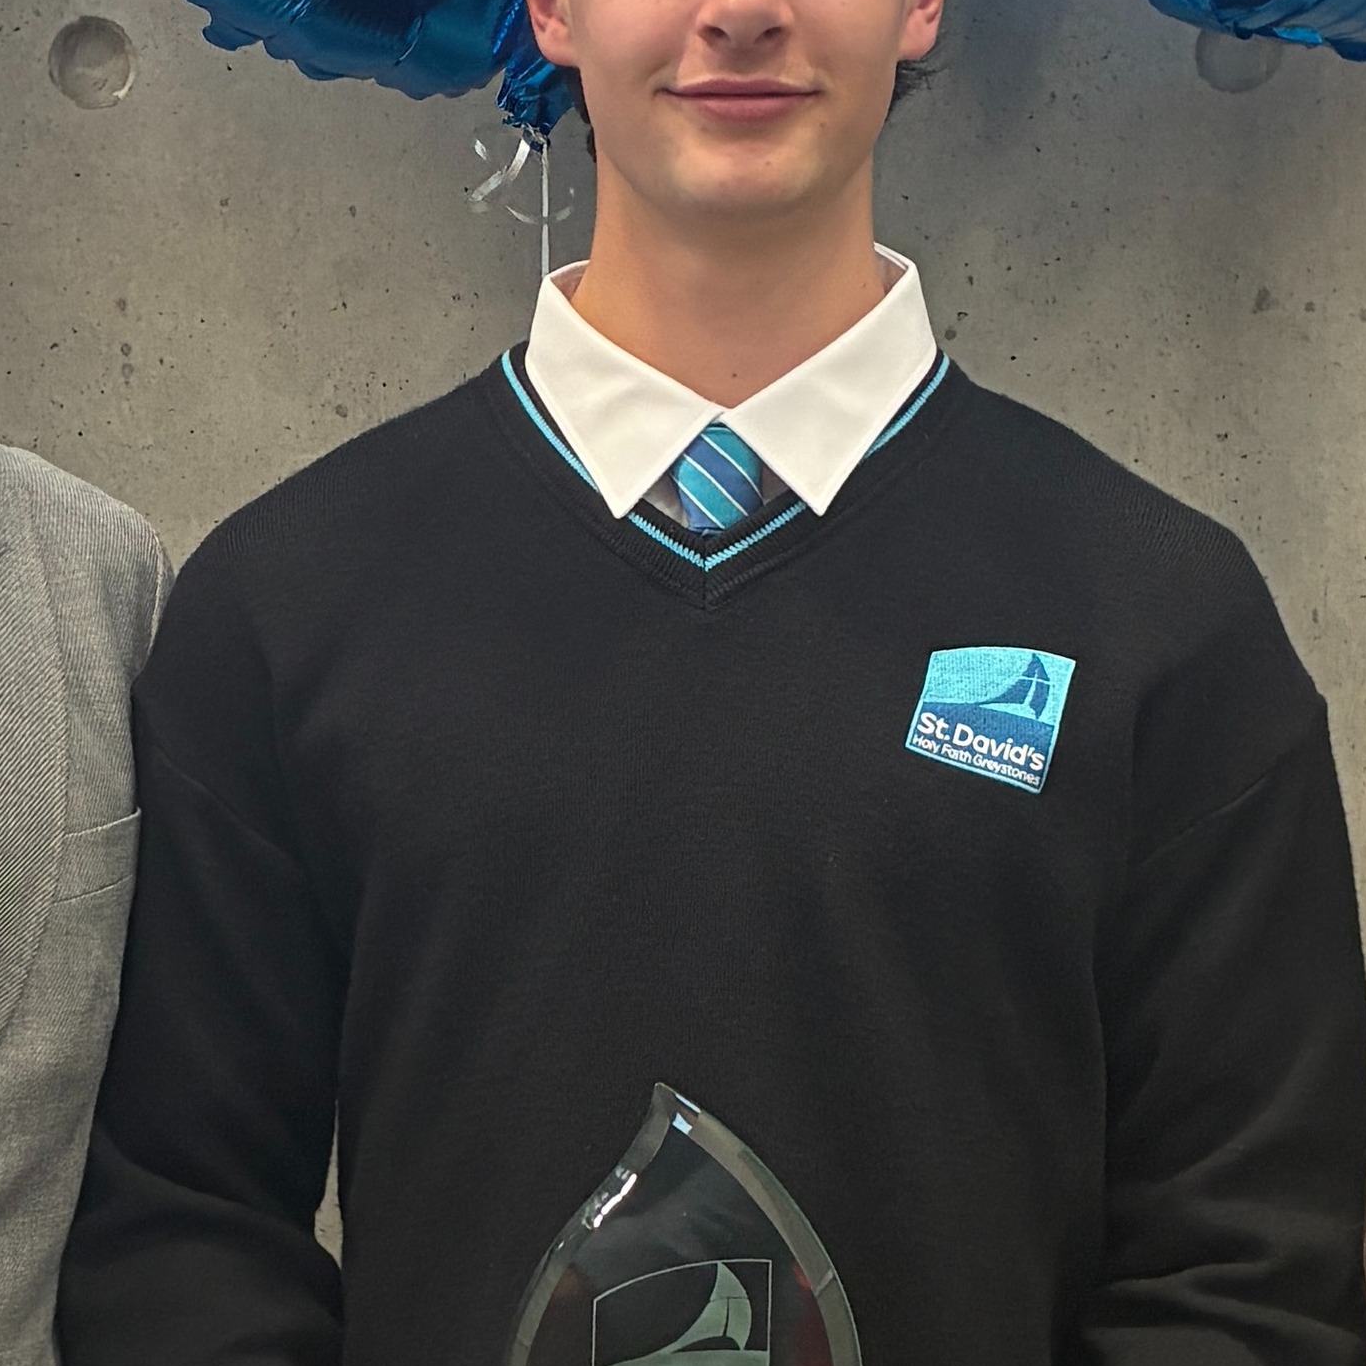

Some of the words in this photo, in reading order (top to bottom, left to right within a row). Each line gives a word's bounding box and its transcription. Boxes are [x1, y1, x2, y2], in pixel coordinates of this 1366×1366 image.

[912, 734, 940, 753] Holy
[942, 744, 972, 762] Faith
[917, 712, 950, 740] St.
[952, 723, 1045, 770] David's
